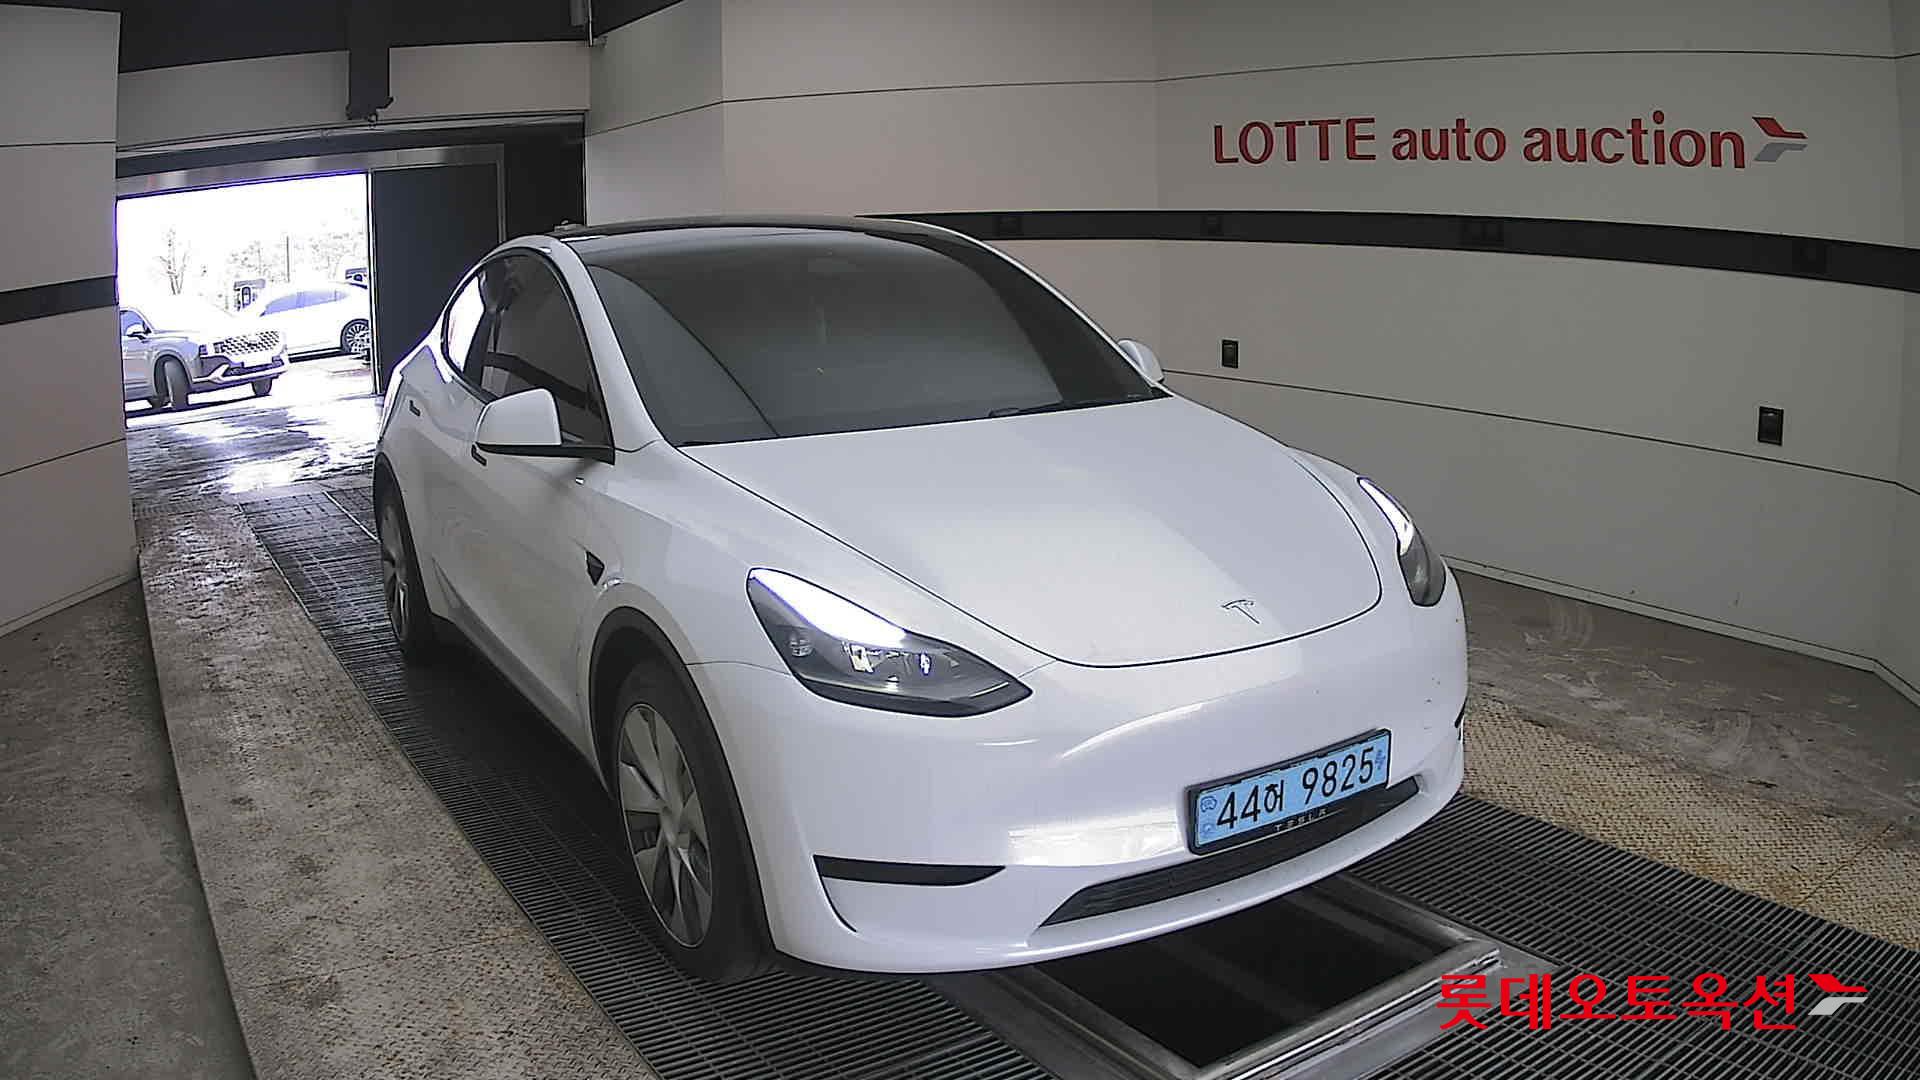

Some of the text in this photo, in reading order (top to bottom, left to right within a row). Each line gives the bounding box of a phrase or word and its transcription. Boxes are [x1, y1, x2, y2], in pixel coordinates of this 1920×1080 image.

[1215, 111, 1746, 168] LOTTE auto auction
[1216, 746, 1374, 829] 44허 9825
